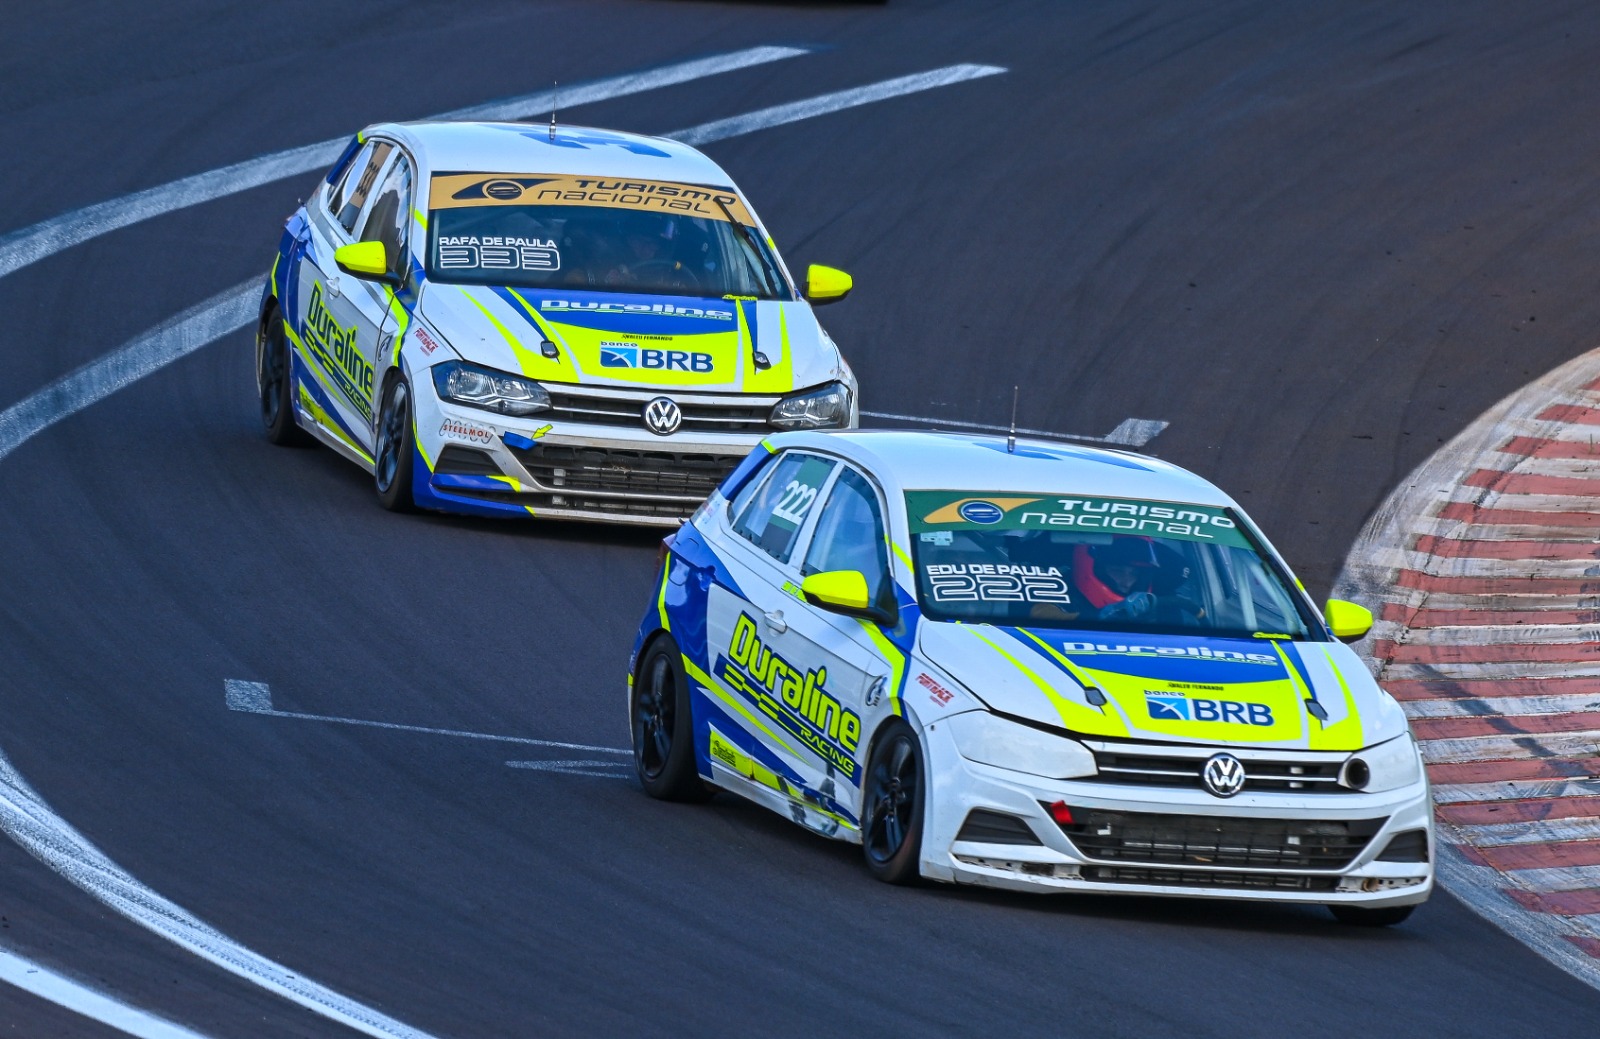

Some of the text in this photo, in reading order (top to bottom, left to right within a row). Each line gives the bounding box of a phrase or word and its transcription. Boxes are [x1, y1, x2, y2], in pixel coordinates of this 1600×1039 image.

[575, 179, 737, 206] TURISMO
[439, 236, 557, 249] RAFA DE PAULA
[439, 246, 561, 271] 333
[541, 300, 733, 317] Duraline
[304, 279, 373, 401] Duraline
[641, 349, 714, 373] BRB
[443, 424, 490, 439] STEELMOL
[772, 480, 817, 525] 222
[1057, 499, 1237, 529] TURISMO
[926, 564, 1063, 578] EDU DE PAULA
[929, 575, 1071, 604] 222
[1063, 642, 1277, 661] Duraline
[728, 610, 861, 757] Duraline
[1144, 689, 1186, 697] banco
[1191, 698, 1275, 727] BRB
[800, 728, 855, 773] RACING
